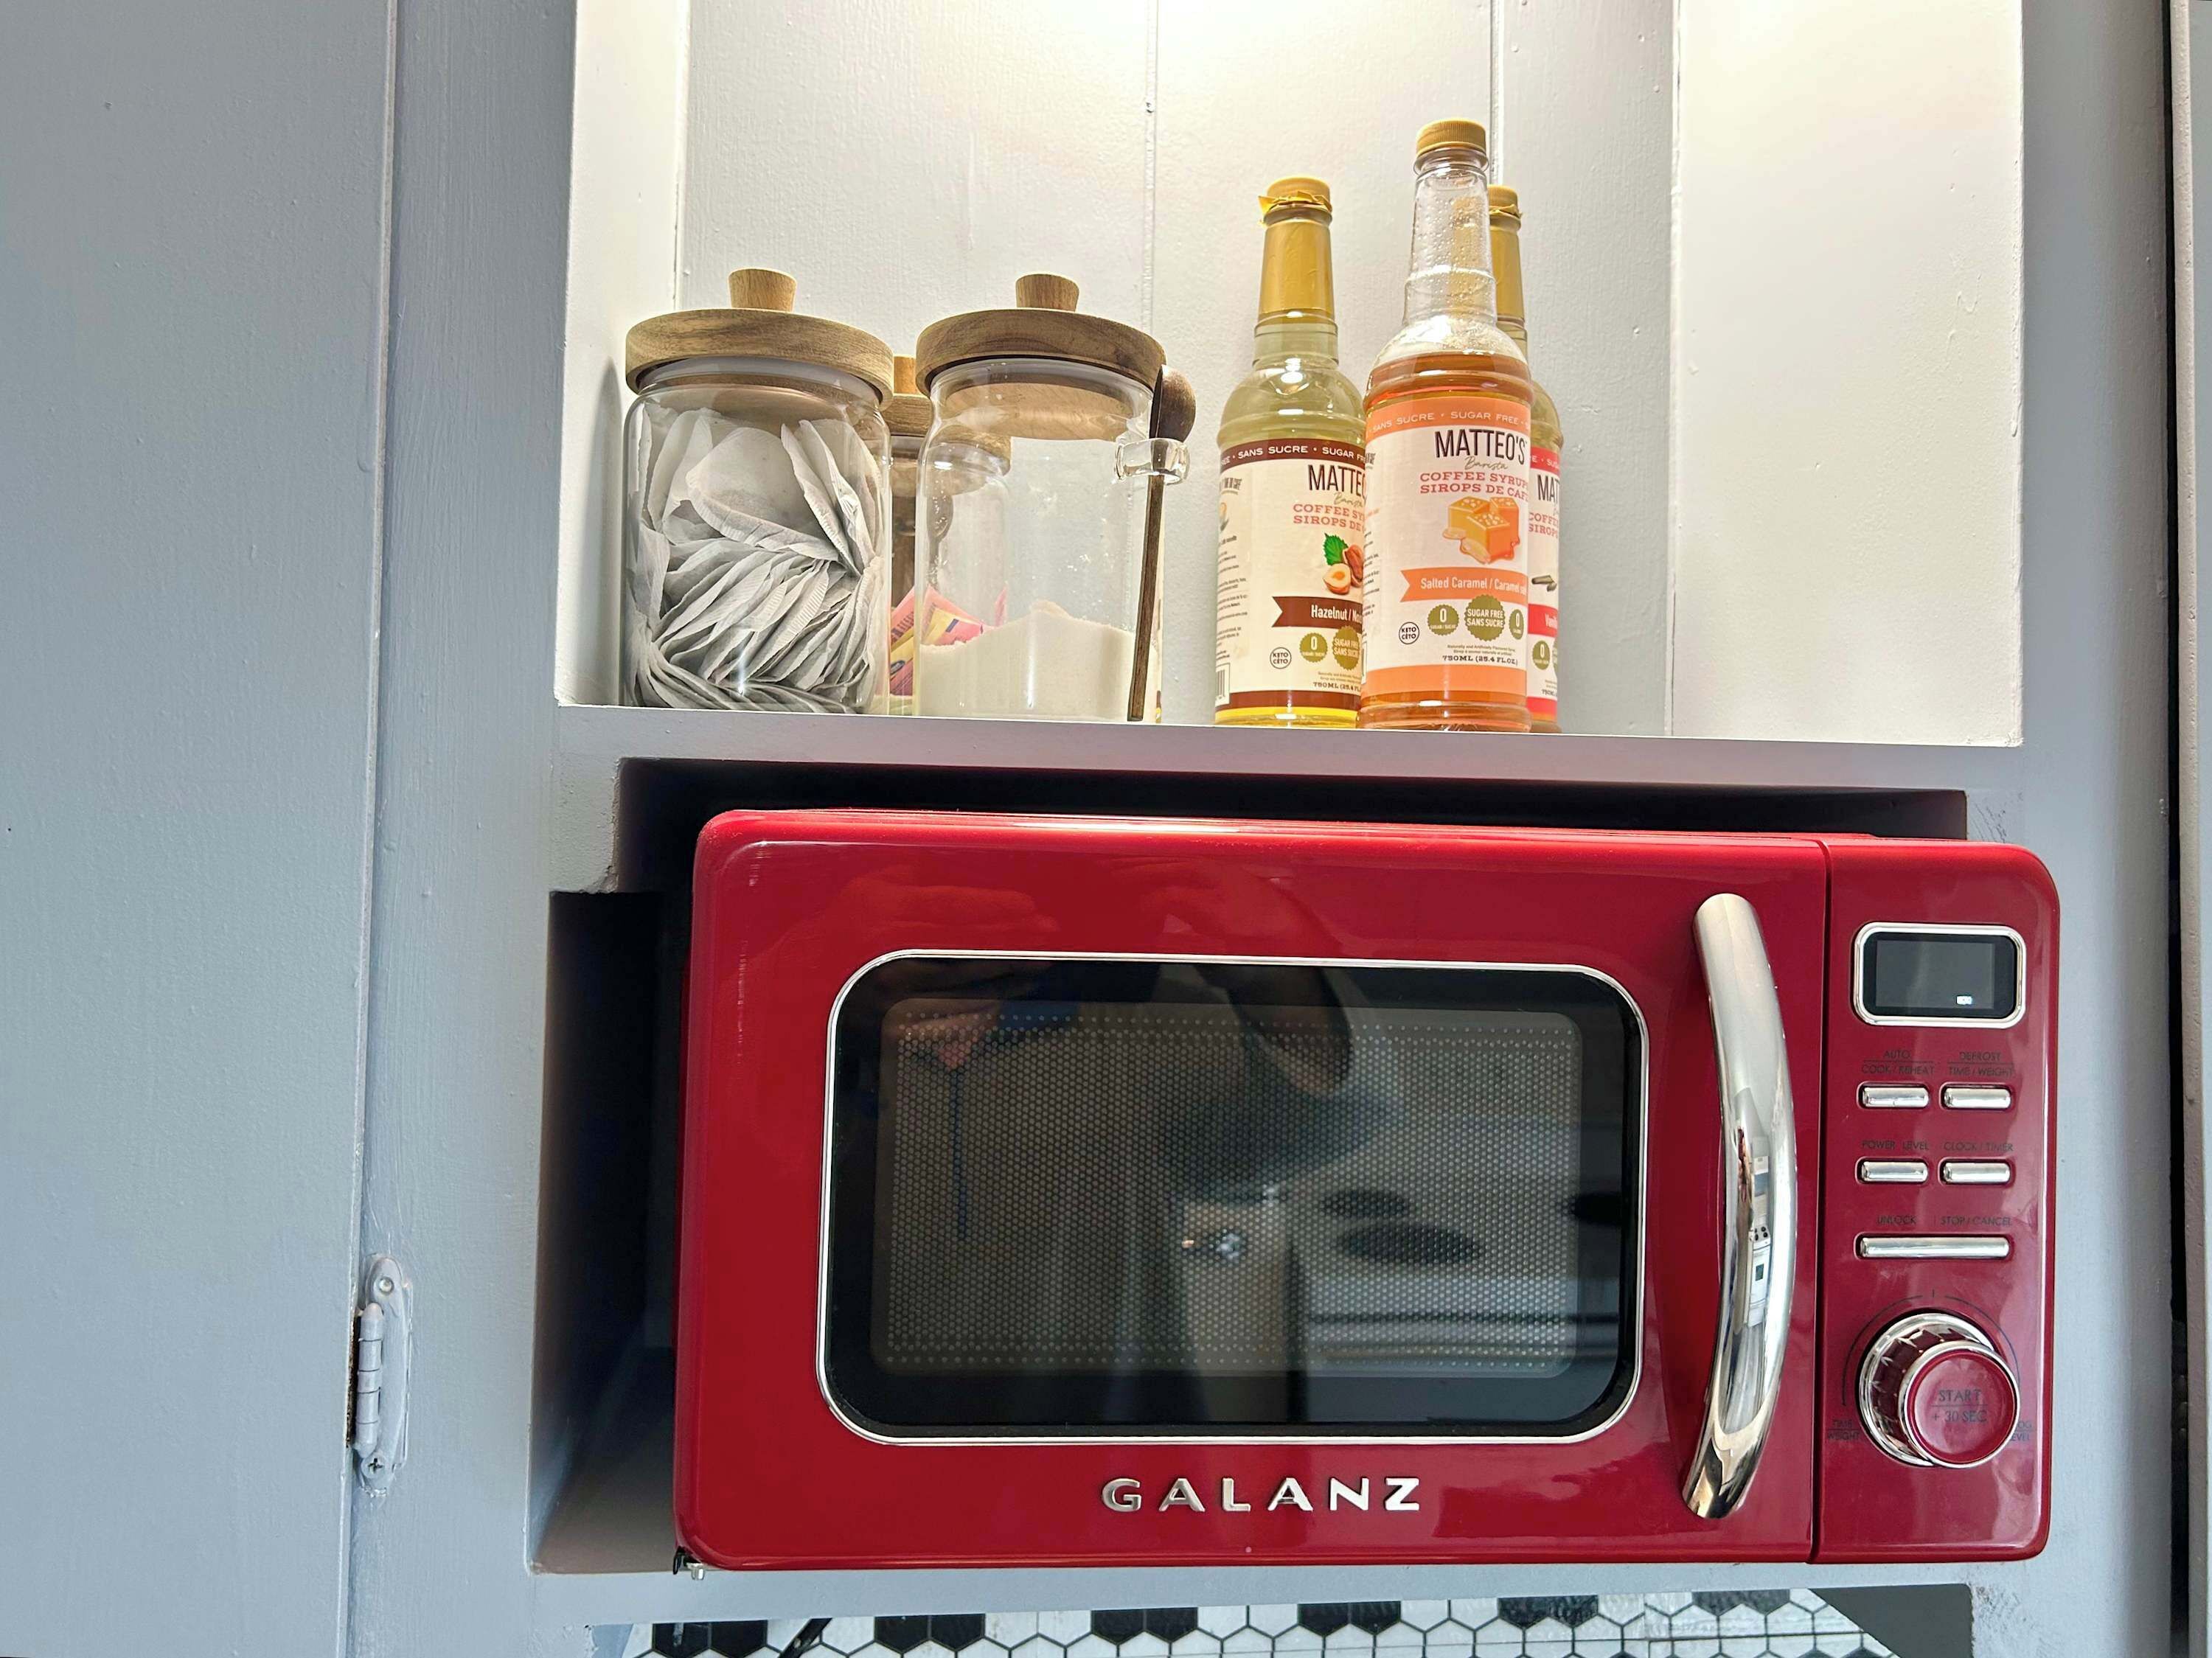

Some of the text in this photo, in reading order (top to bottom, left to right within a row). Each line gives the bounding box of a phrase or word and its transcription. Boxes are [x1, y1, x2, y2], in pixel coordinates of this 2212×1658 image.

[1397, 413, 1434, 425] SUCRE
[1450, 411, 1491, 420] SUGAR
[1495, 414, 1519, 425] FREE
[1238, 448, 1263, 459] SANS
[1268, 445, 1308, 454] SUCRE
[1322, 447, 1354, 459] SUGAR
[1435, 428, 1525, 465] MATTEO'S
[1465, 456, 1508, 470] Barista
[1420, 472, 1528, 489] COFFEE SYRUP
[1420, 484, 1528, 501] SIROPS DE CAF
[1293, 504, 1349, 516] COFFEE
[1293, 515, 1361, 531] SIROPS DE
[1420, 577, 1450, 590] Salted
[1452, 577, 1487, 589] Caramel
[1311, 604, 1348, 621] Hazelnut
[1440, 607, 1447, 623] 0
[1467, 609, 1503, 619] SUGAR FREE
[1467, 618, 1504, 627] SANS SUCRE
[1311, 635, 1318, 650] 0
[1884, 1051, 1911, 1059] AUTO
[1960, 1052, 2001, 1061] DEFROST
[1862, 1141, 1929, 1151] POWER LEVEL
[1939, 1389, 1981, 1401] START
[1945, 1410, 1959, 1421] 30
[1963, 1410, 1987, 1422] SEC
[1102, 1477, 1419, 1512] GALANZ
